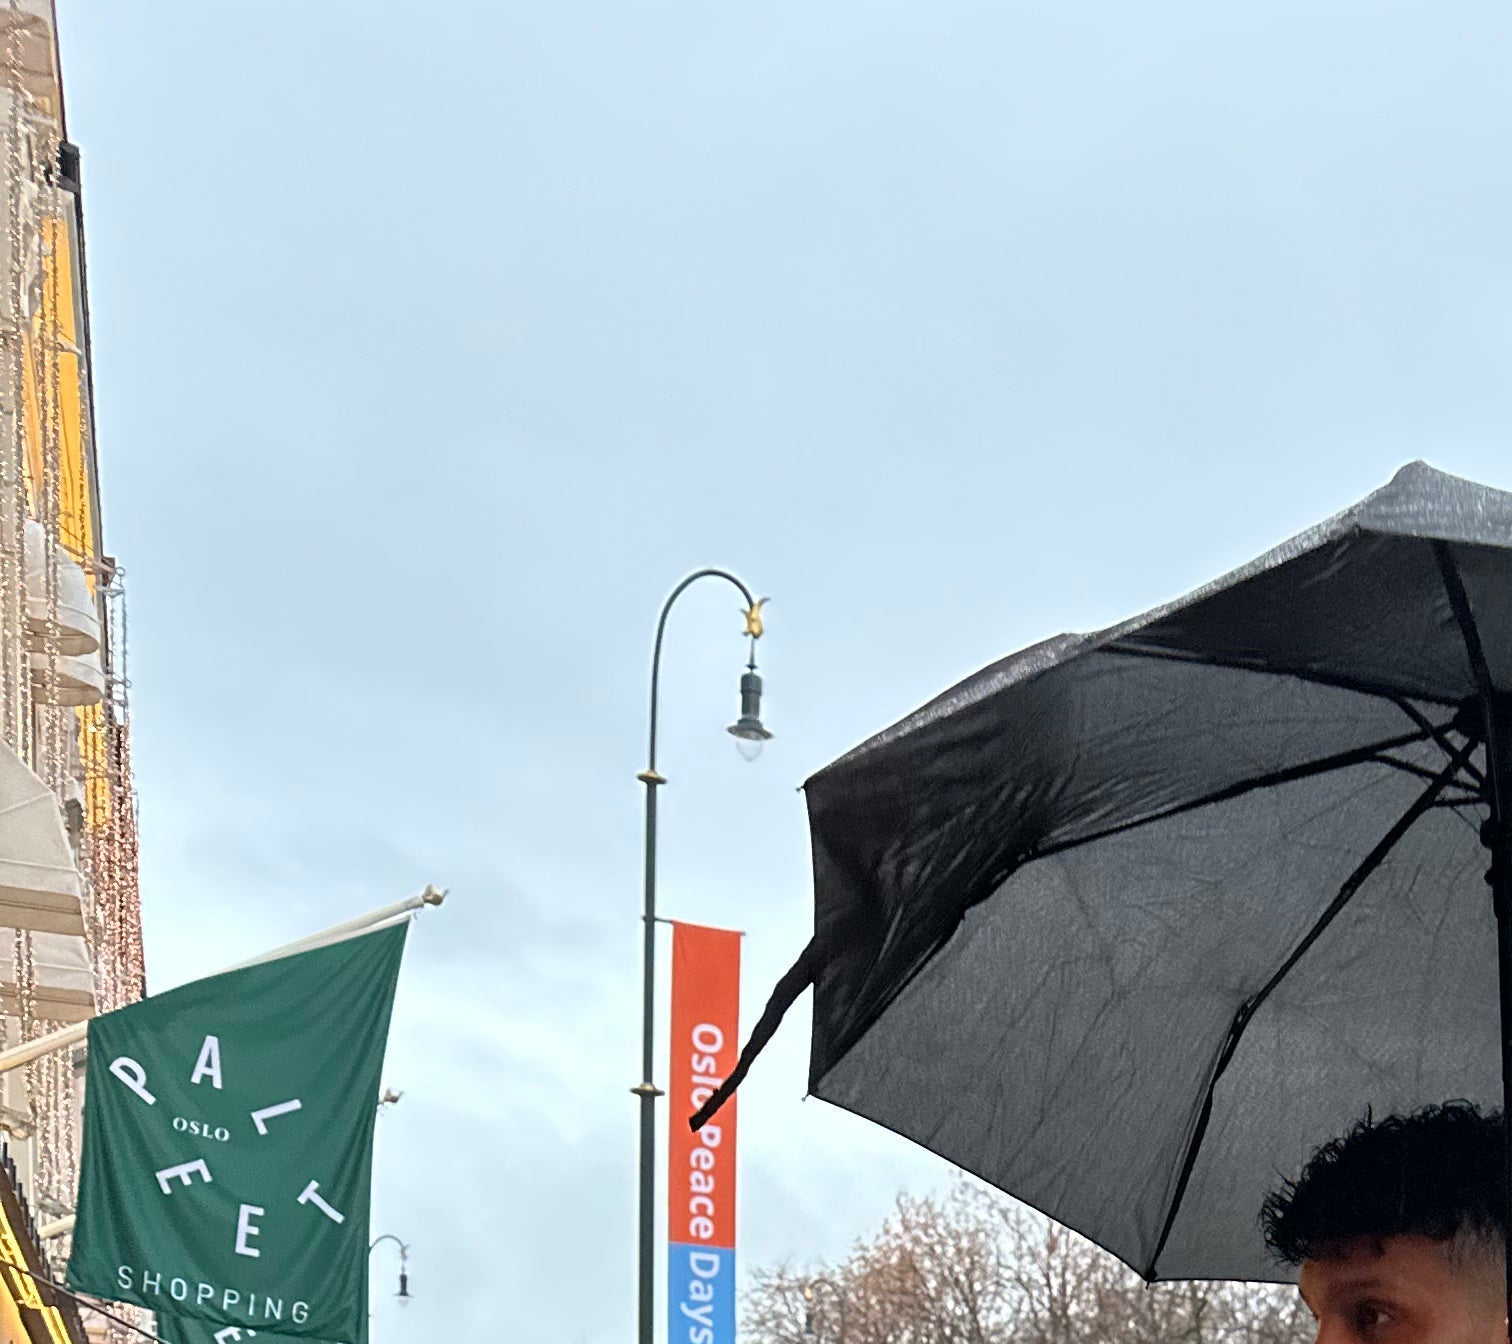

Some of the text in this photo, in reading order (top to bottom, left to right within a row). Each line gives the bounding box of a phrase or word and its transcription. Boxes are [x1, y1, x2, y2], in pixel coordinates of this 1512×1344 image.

[172, 1116, 230, 1142] OSLO
[689, 1124, 721, 1239] Peace
[117, 1265, 310, 1324] SHOPPING
[680, 1251, 720, 1344] Days
